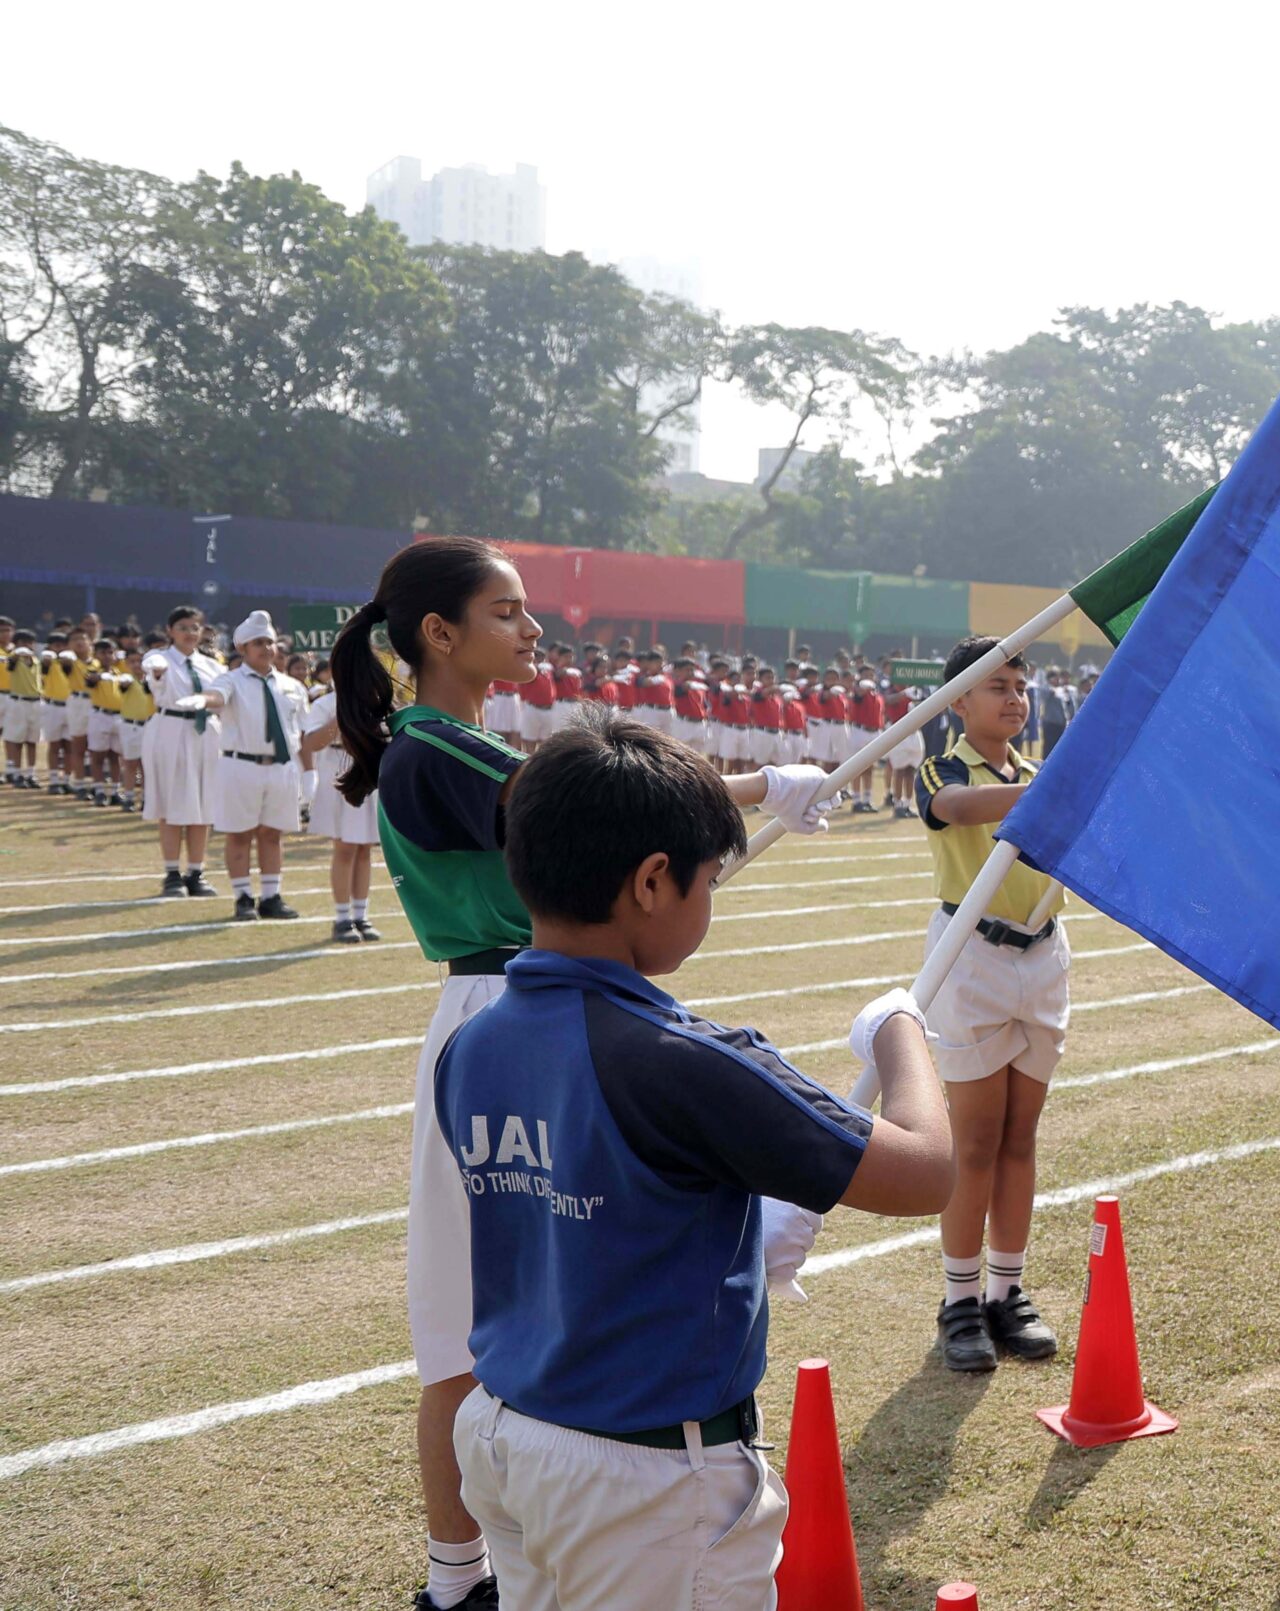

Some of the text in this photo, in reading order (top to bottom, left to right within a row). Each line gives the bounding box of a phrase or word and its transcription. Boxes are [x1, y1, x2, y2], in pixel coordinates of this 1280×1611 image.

[207, 527, 218, 563] JAL
[294, 630, 340, 648] ME
[460, 1115, 553, 1171] JAL
[486, 1171, 534, 1195] THINK
